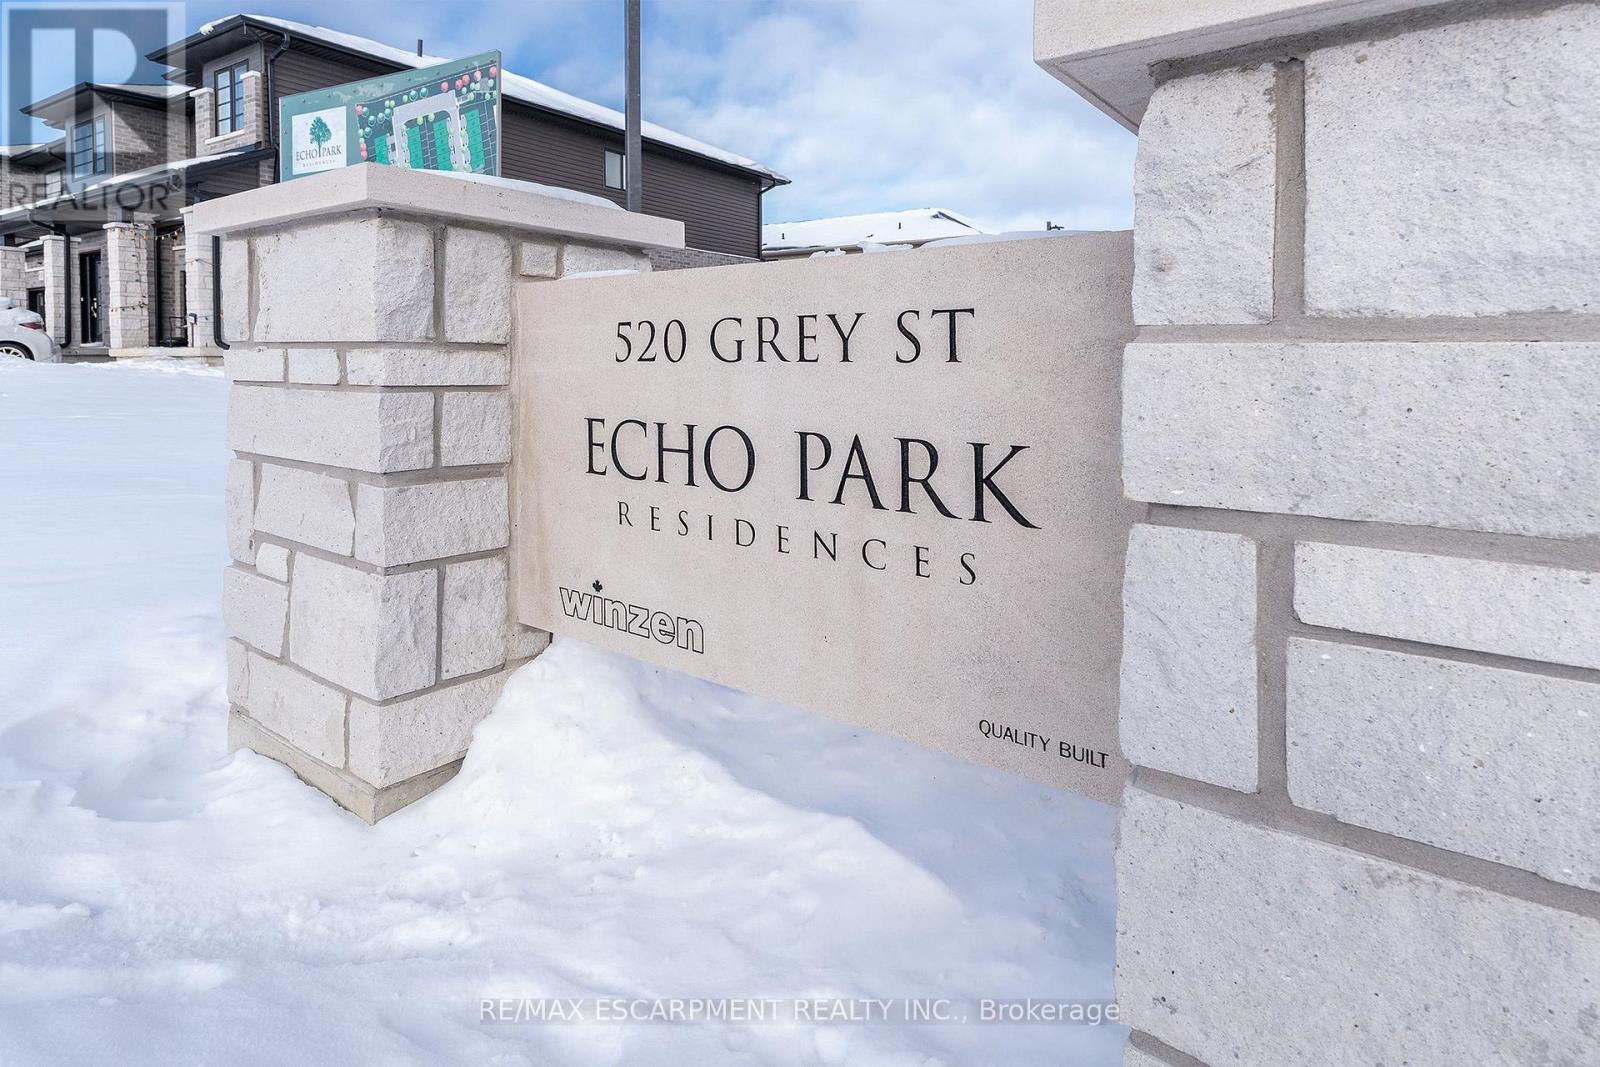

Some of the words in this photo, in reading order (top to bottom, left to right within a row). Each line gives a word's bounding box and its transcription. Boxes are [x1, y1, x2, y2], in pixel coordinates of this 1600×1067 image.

[296, 148, 317, 161] ECHO
[322, 145, 342, 157] PARK
[615, 319, 687, 363] 520
[709, 312, 866, 363] GREY
[895, 307, 975, 363] ST
[584, 417, 756, 493] ECHO
[794, 431, 1042, 530] PARK
[617, 500, 977, 586] RESIDENCES
[559, 579, 704, 654] winzen
[978, 719, 1051, 752] QUALITY
[1059, 741, 1109, 769] BUILT
